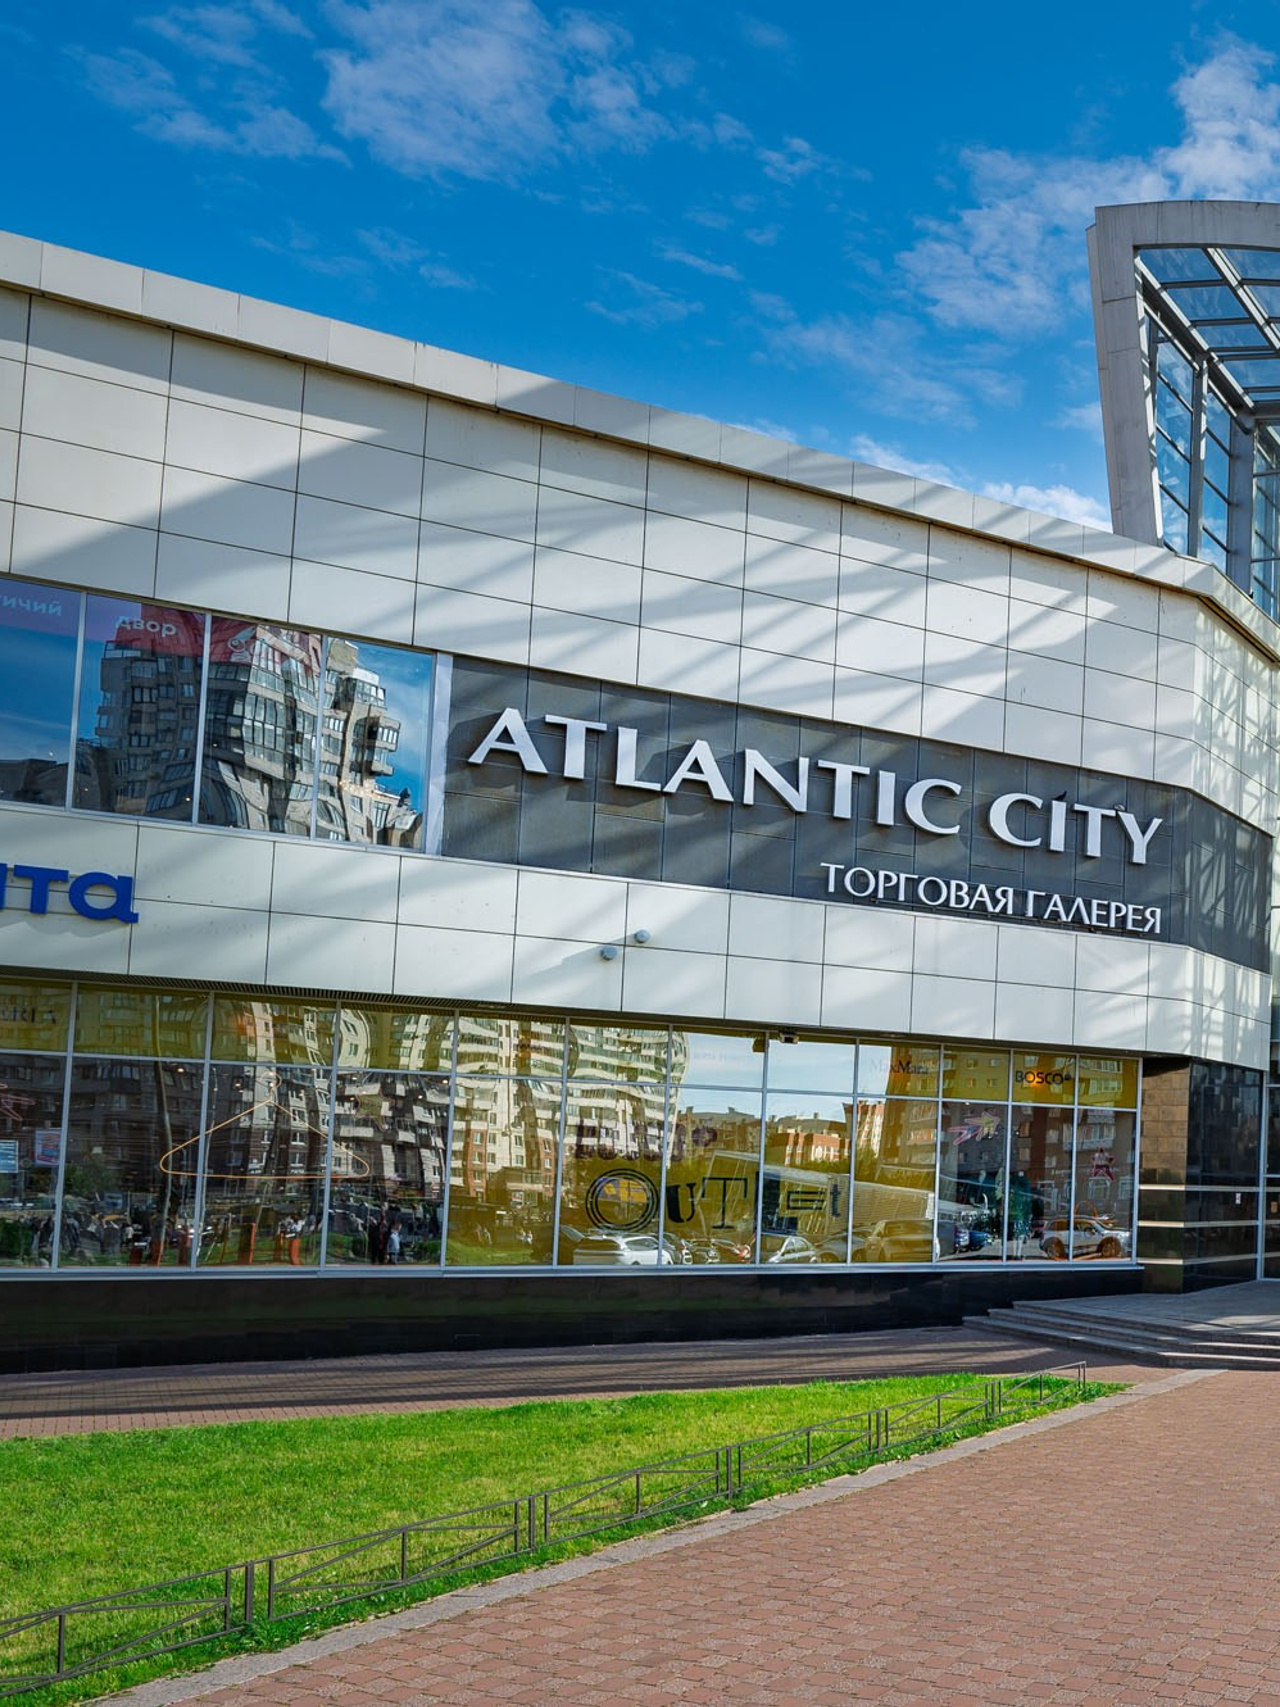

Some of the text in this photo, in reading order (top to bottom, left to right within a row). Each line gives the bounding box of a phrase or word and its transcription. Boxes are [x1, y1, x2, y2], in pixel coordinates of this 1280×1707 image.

[0, 594, 62, 617] ичий
[467, 707, 1163, 865] ATLANTIC CITY
[0, 863, 139, 924] та
[820, 862, 1161, 934] ТОРГОВАЯ ГАЛЕРЕЯ
[1015, 1069, 1065, 1086] BOSCO
